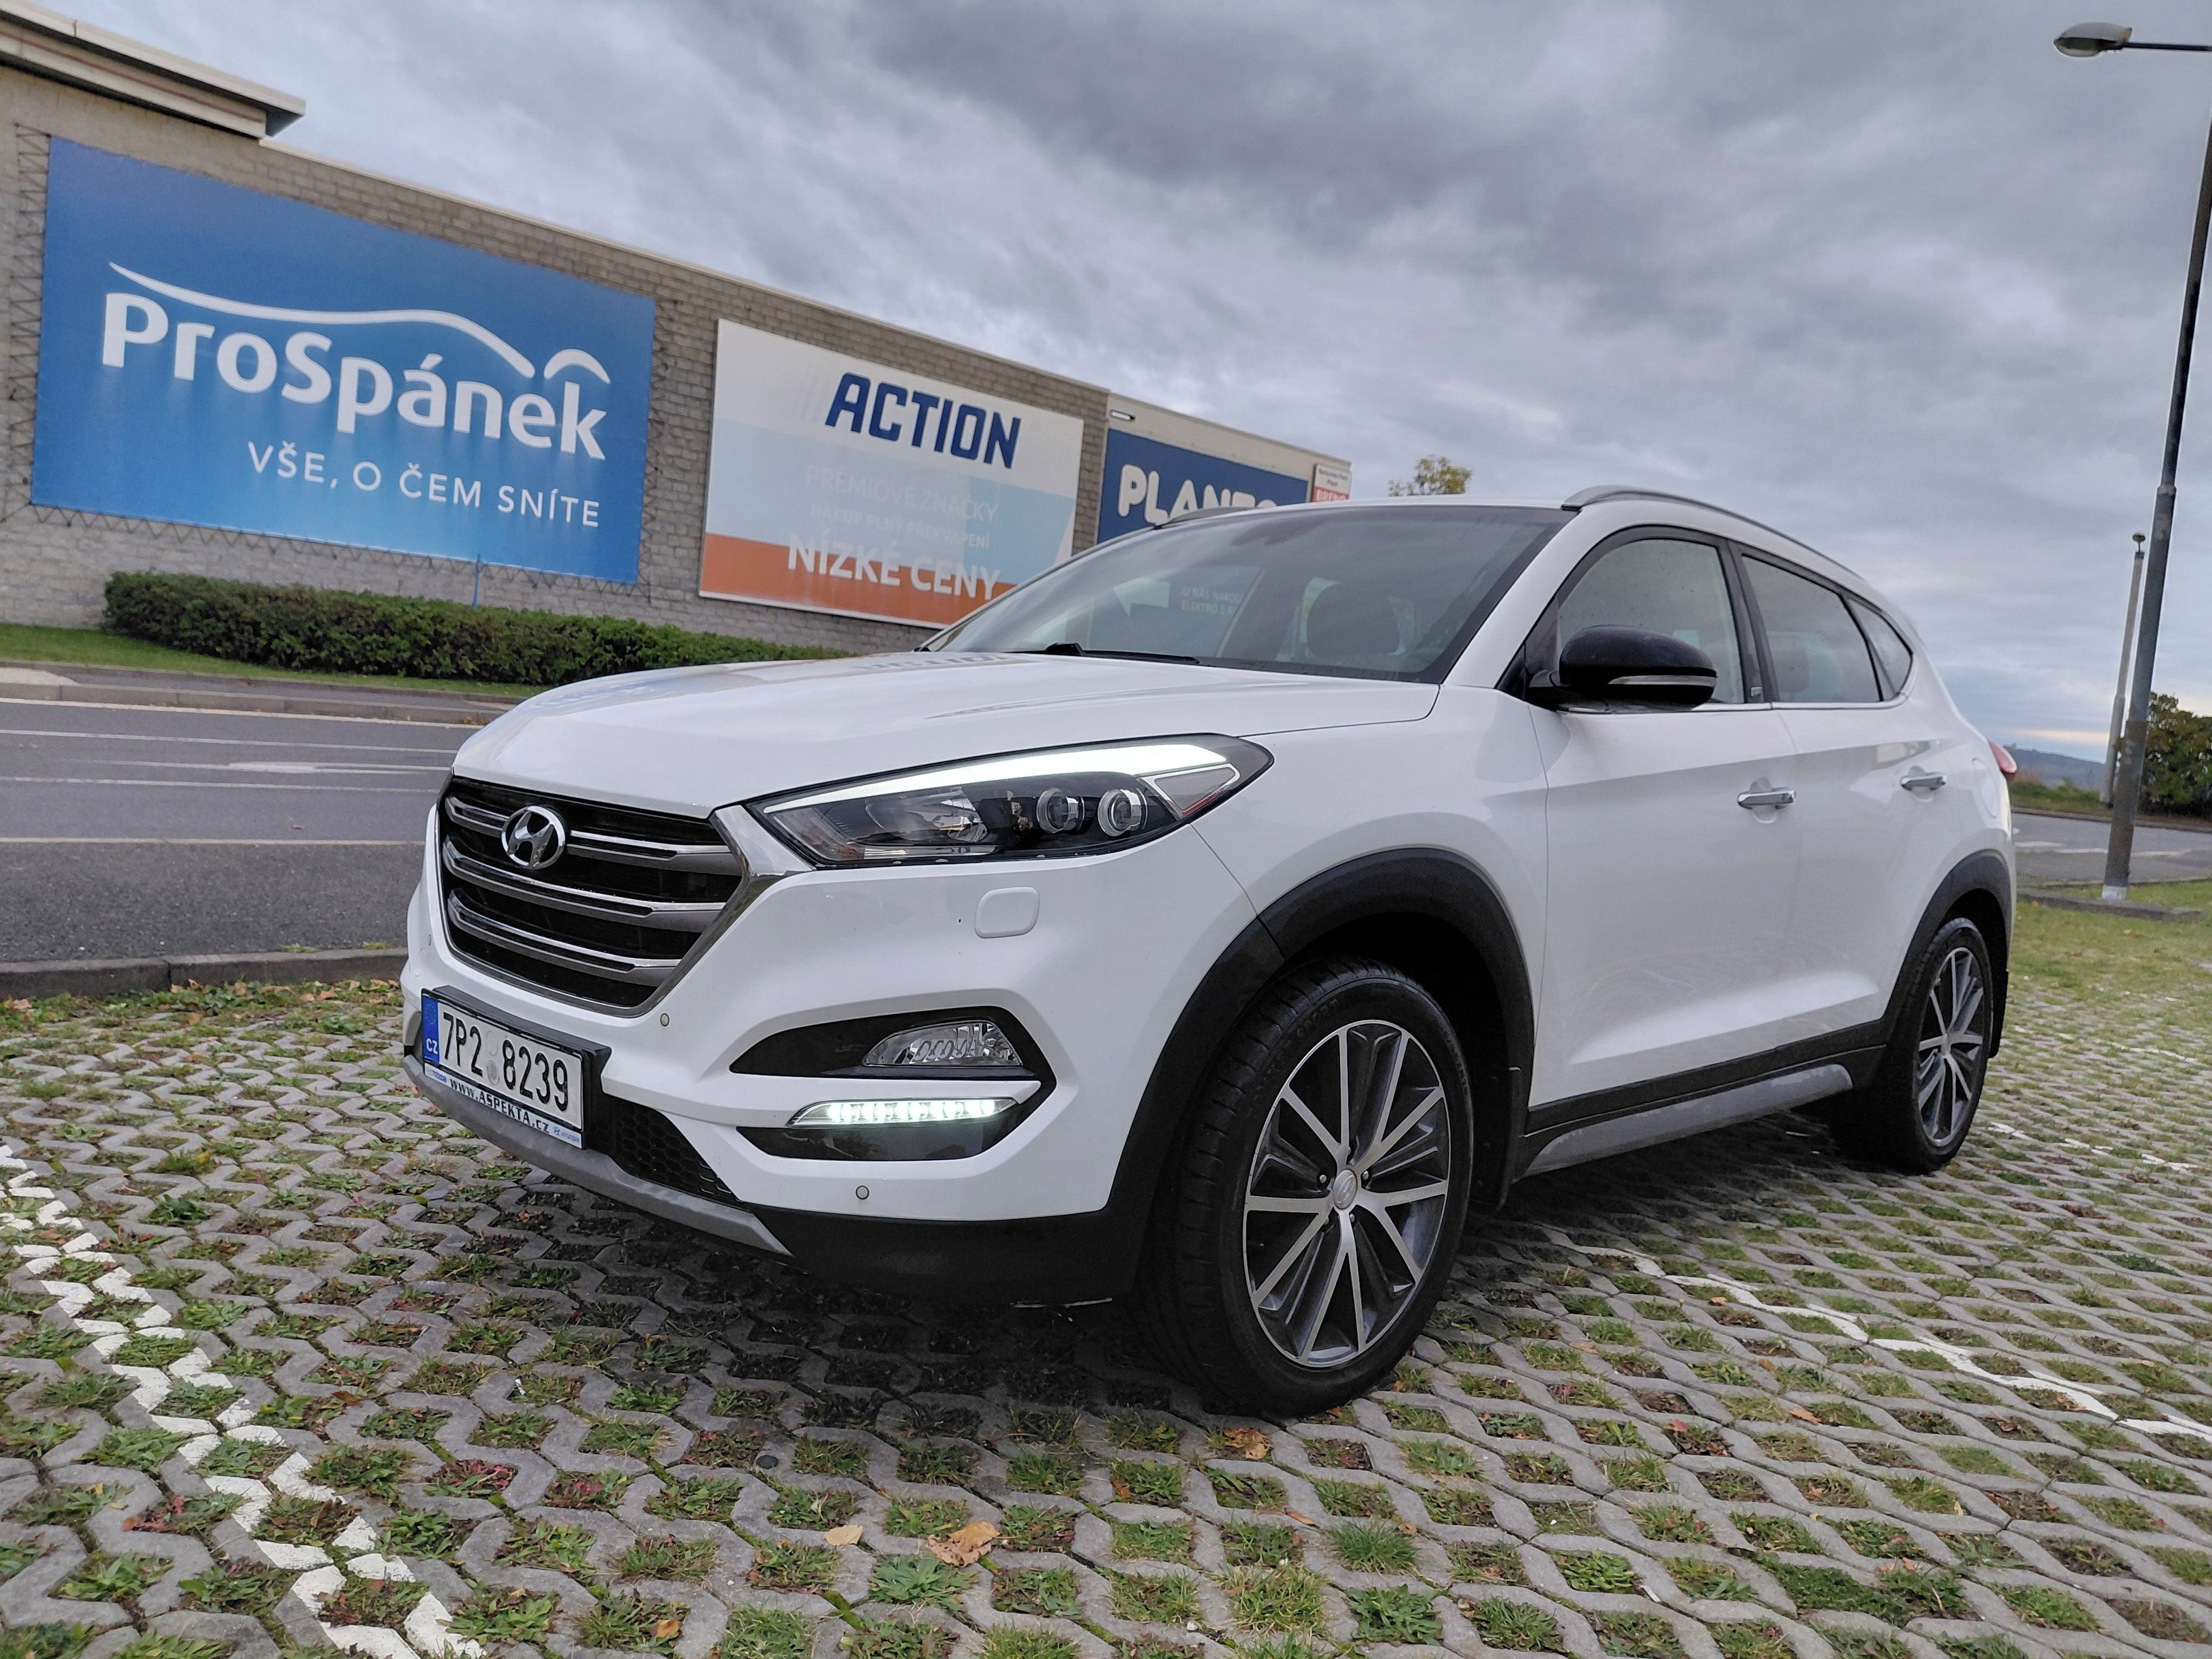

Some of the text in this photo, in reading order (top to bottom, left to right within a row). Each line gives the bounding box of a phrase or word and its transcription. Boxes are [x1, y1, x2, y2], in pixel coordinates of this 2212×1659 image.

[101, 292, 607, 460] ProSpánek
[825, 371, 1022, 470] ACTION
[247, 440, 600, 528] VŠE, O ČEM SNÍTE
[1118, 464, 1278, 524] PLAN
[788, 527, 1002, 601] NÍZKÉ CENY
[426, 1038, 438, 1054] CZ
[443, 1011, 569, 1112] 7P2 8239
